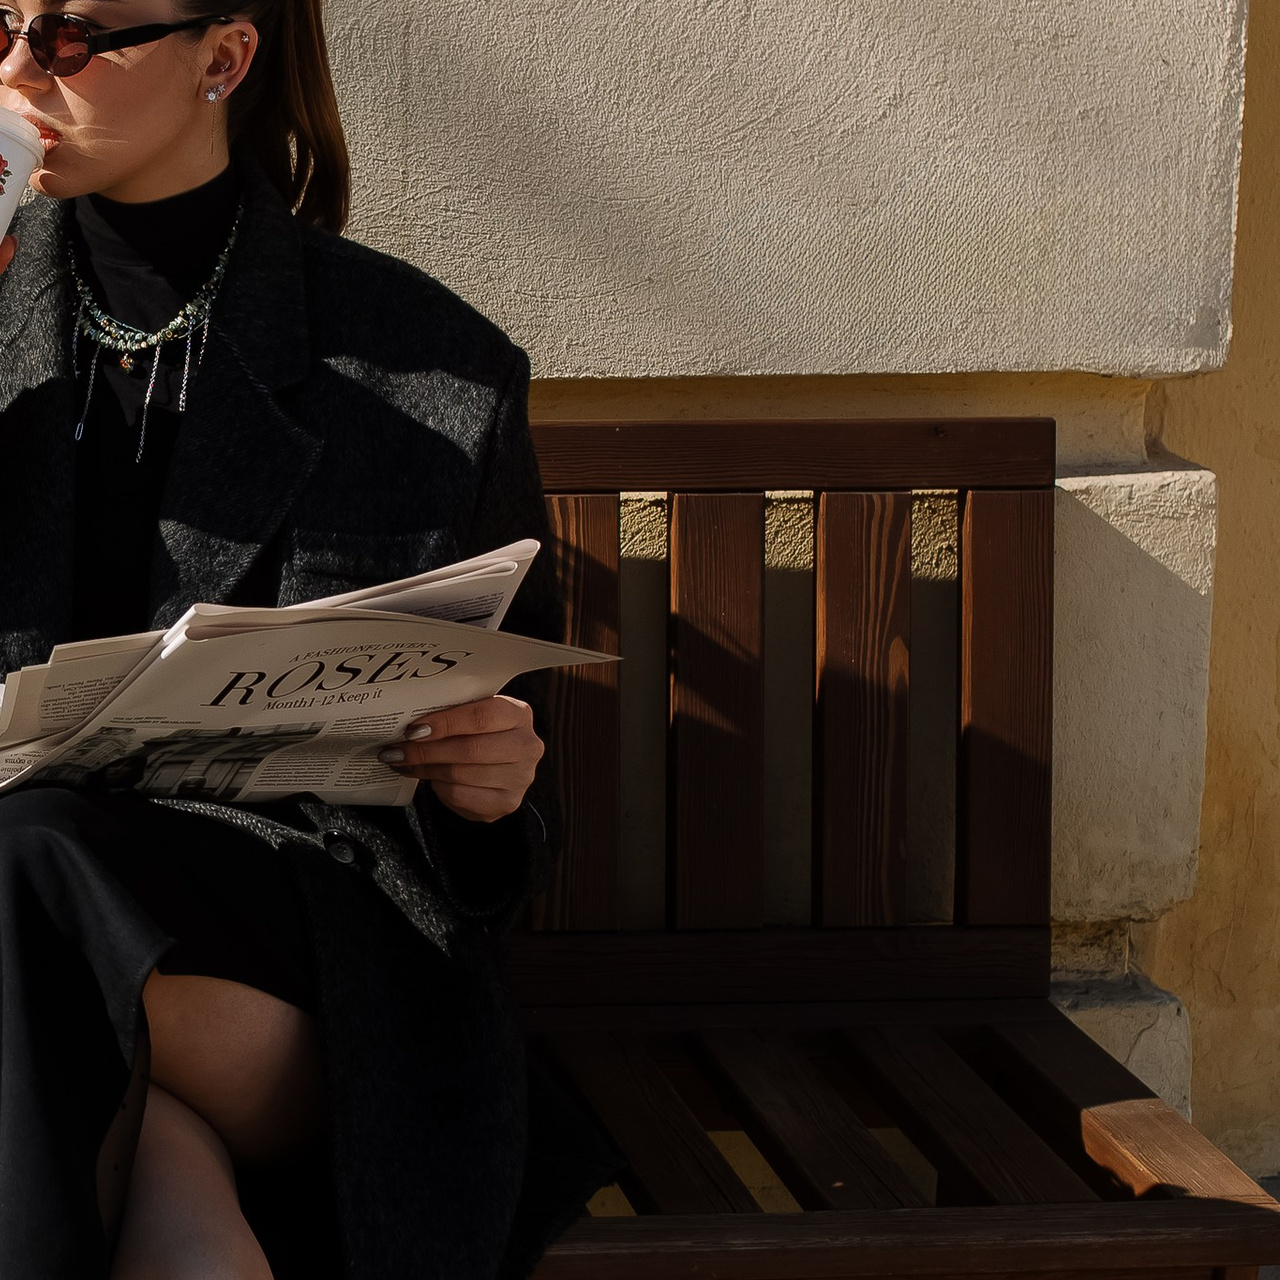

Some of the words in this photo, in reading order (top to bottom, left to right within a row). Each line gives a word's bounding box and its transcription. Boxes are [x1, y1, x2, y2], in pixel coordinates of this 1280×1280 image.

[289, 654, 300, 664] A
[200, 650, 474, 709] ROSES
[336, 691, 370, 704] Keep
[372, 687, 383, 699] it
